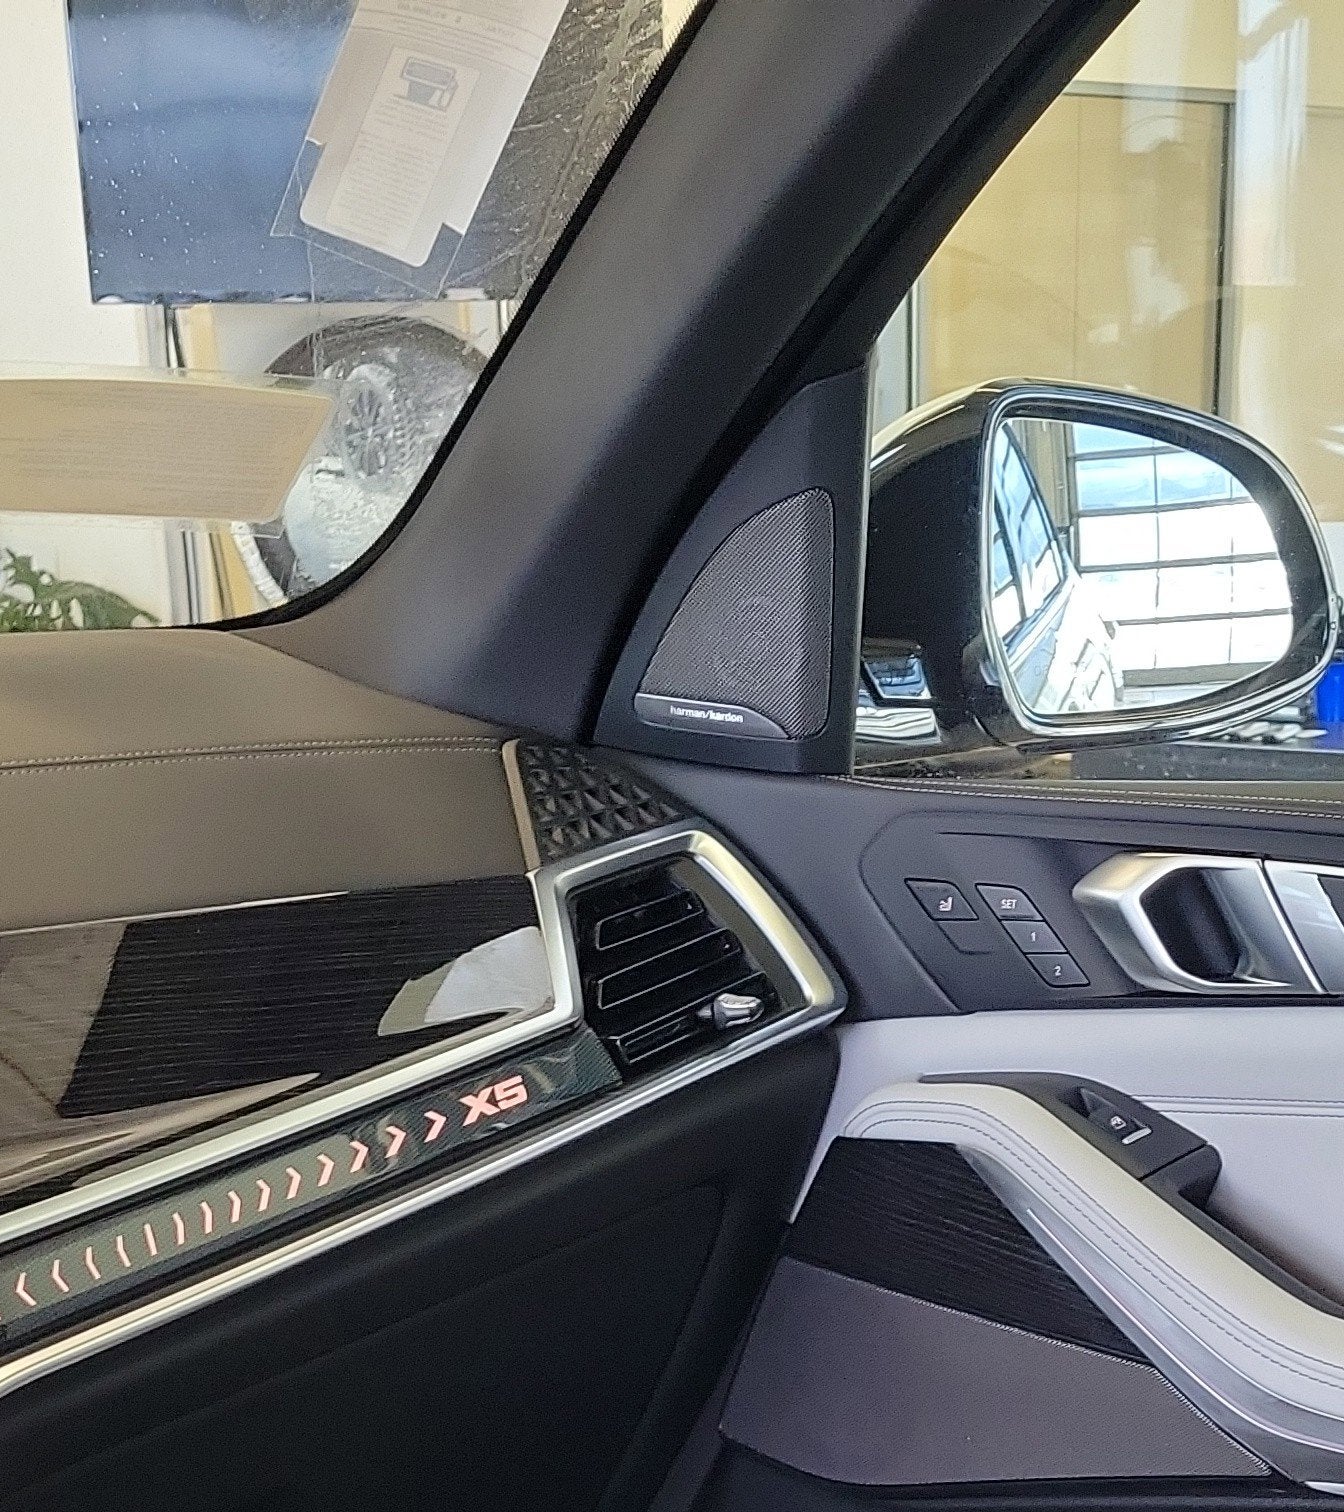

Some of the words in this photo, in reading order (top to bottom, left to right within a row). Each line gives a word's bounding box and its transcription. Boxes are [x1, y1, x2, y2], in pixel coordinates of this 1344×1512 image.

[669, 705, 744, 723] harman/kardon
[1000, 899, 1018, 910] SET
[1030, 931, 1036, 942] 1
[1054, 965, 1062, 976] 2
[459, 1075, 528, 1127] X5
